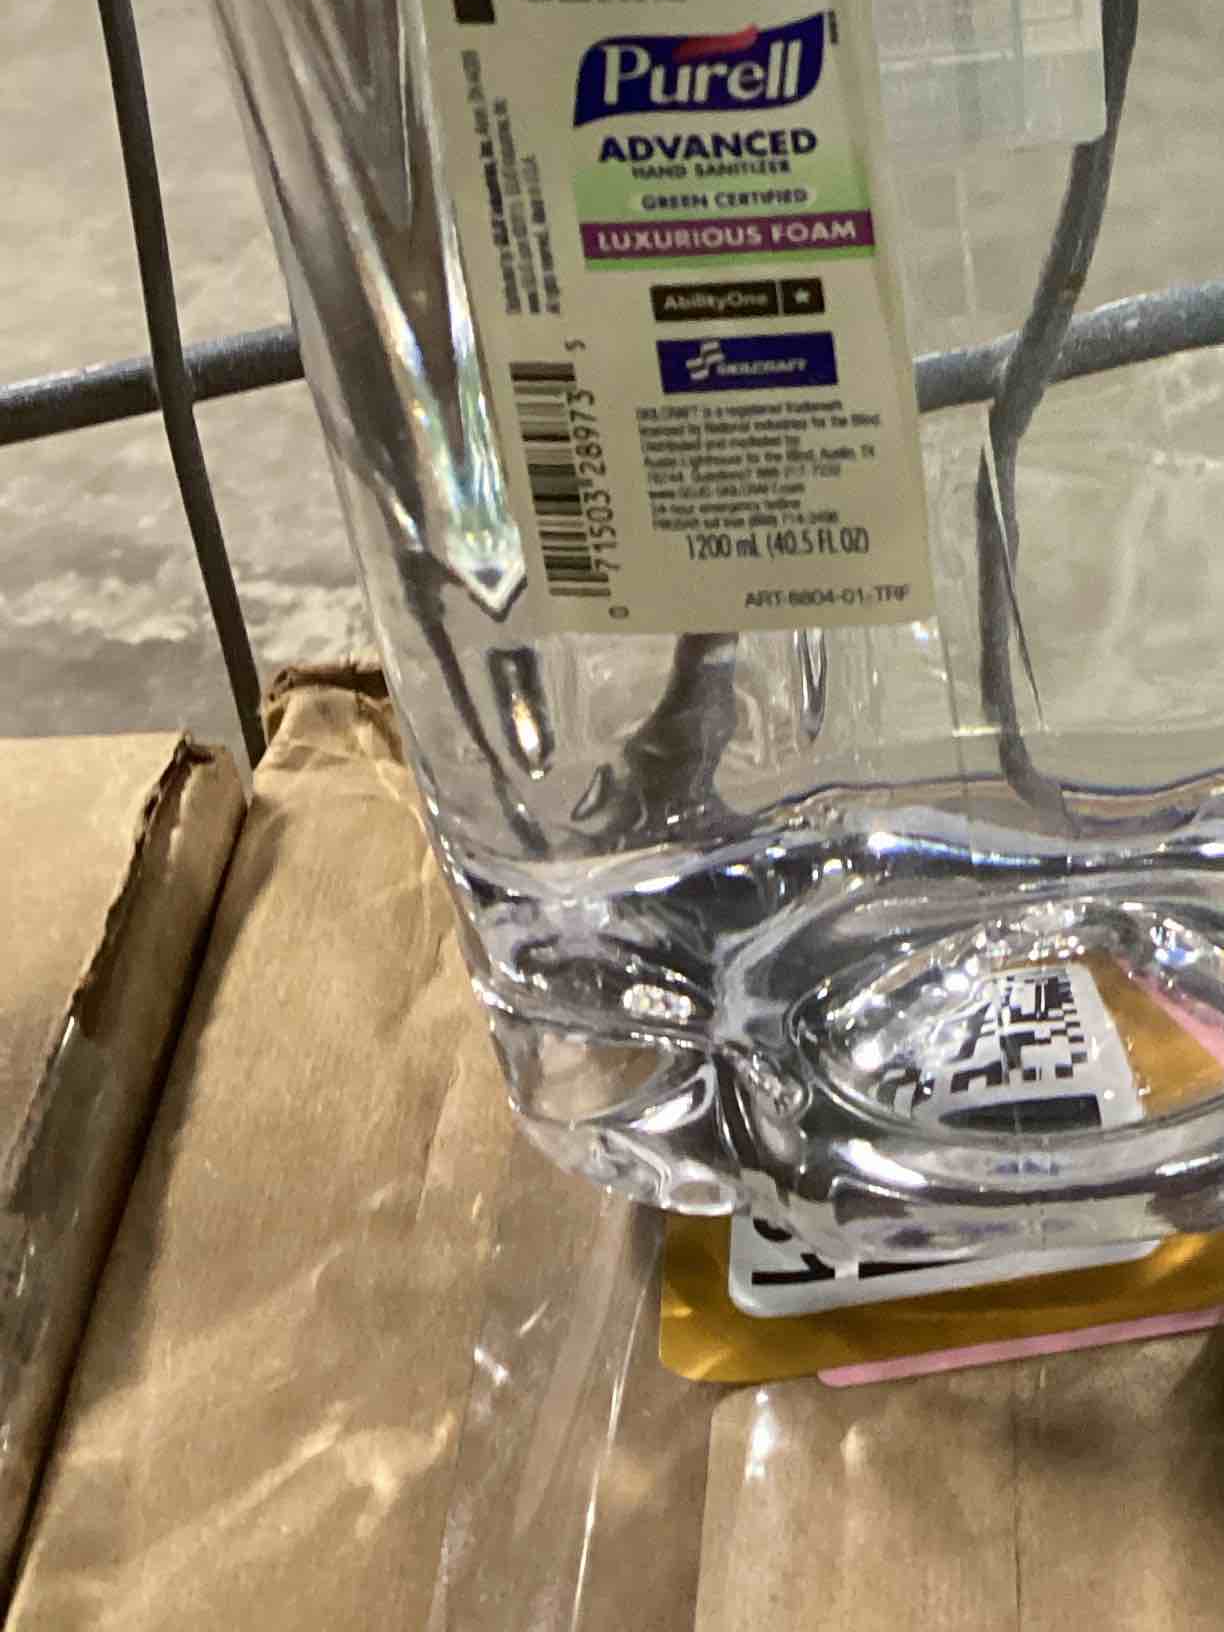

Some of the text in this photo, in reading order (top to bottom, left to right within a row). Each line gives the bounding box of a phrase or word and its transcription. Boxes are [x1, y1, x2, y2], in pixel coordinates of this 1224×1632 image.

[602, 39, 802, 107] Purell
[599, 128, 818, 163] ADVANCED
[597, 219, 857, 252] LUXURIOUS FOAM
[685, 533, 732, 561] 1200
